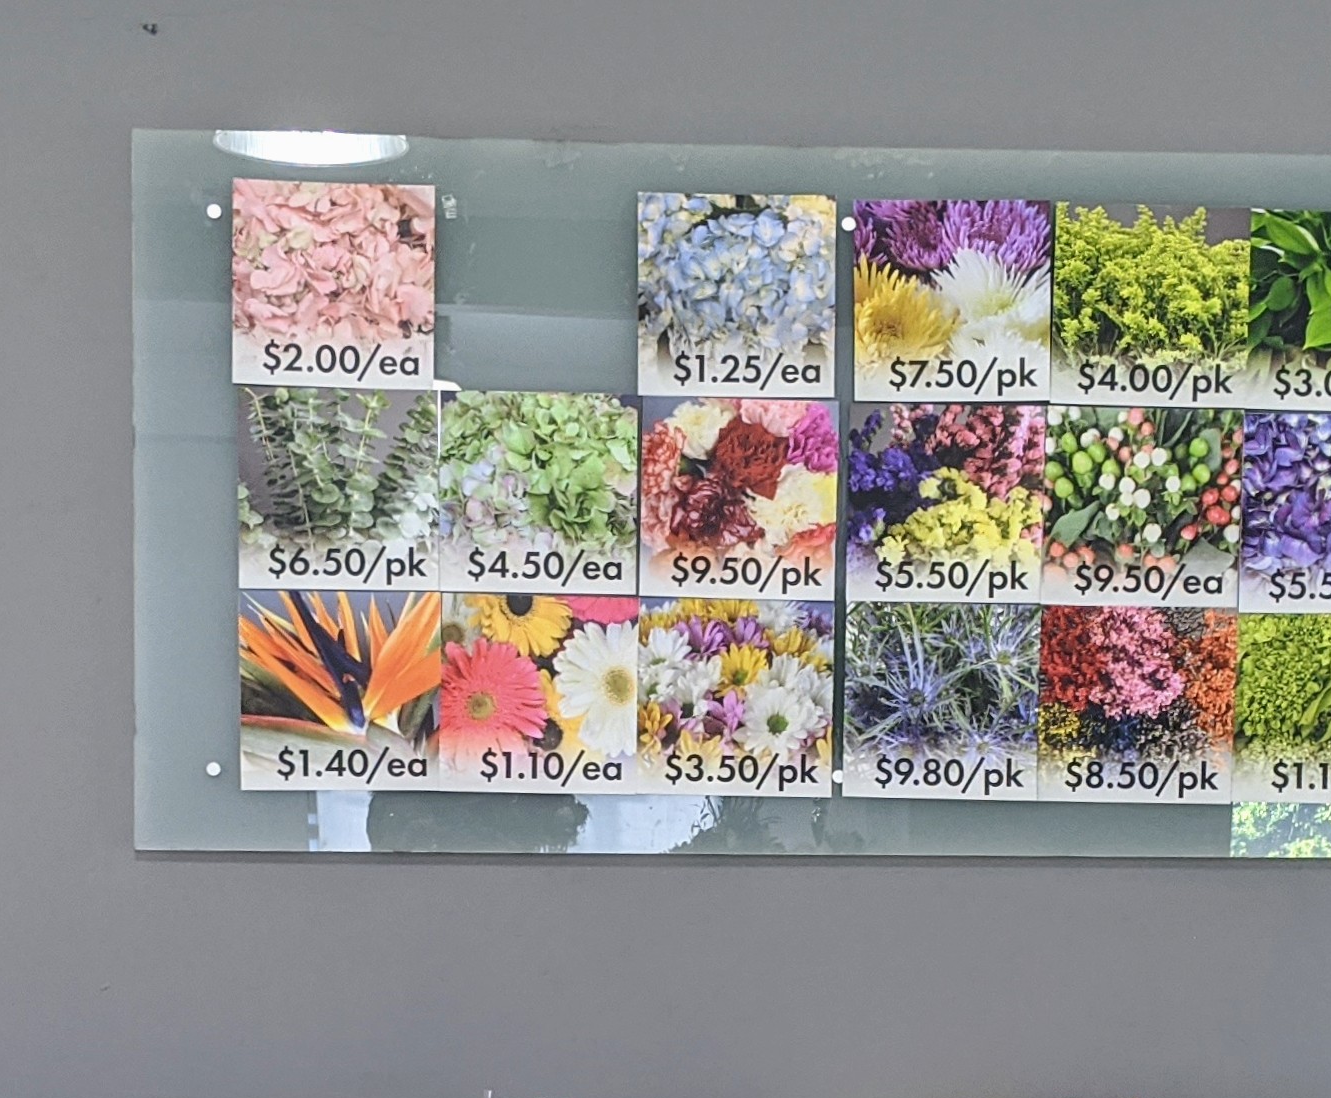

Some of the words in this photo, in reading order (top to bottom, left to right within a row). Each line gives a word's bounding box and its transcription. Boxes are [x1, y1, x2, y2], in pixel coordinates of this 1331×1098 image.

[262, 342, 420, 381] $2.00/ea
[673, 352, 822, 389] $1.25/ea
[888, 357, 1038, 391] $7.50/pk
[1077, 362, 1233, 399] $4.00/pk
[267, 545, 428, 582] $6.50/pk
[467, 548, 623, 587] $4.50/ea
[671, 553, 822, 591] $9.50/pk
[875, 559, 1029, 596] $5.50/pk
[1073, 563, 1224, 600] $9.50/ea
[276, 745, 429, 784] $1.40/ea
[479, 749, 623, 787] $1.10/ea
[664, 752, 819, 792] $3.50/pk
[875, 756, 1024, 794] $9.80/pk
[1064, 757, 1218, 798] $8.50/pk
